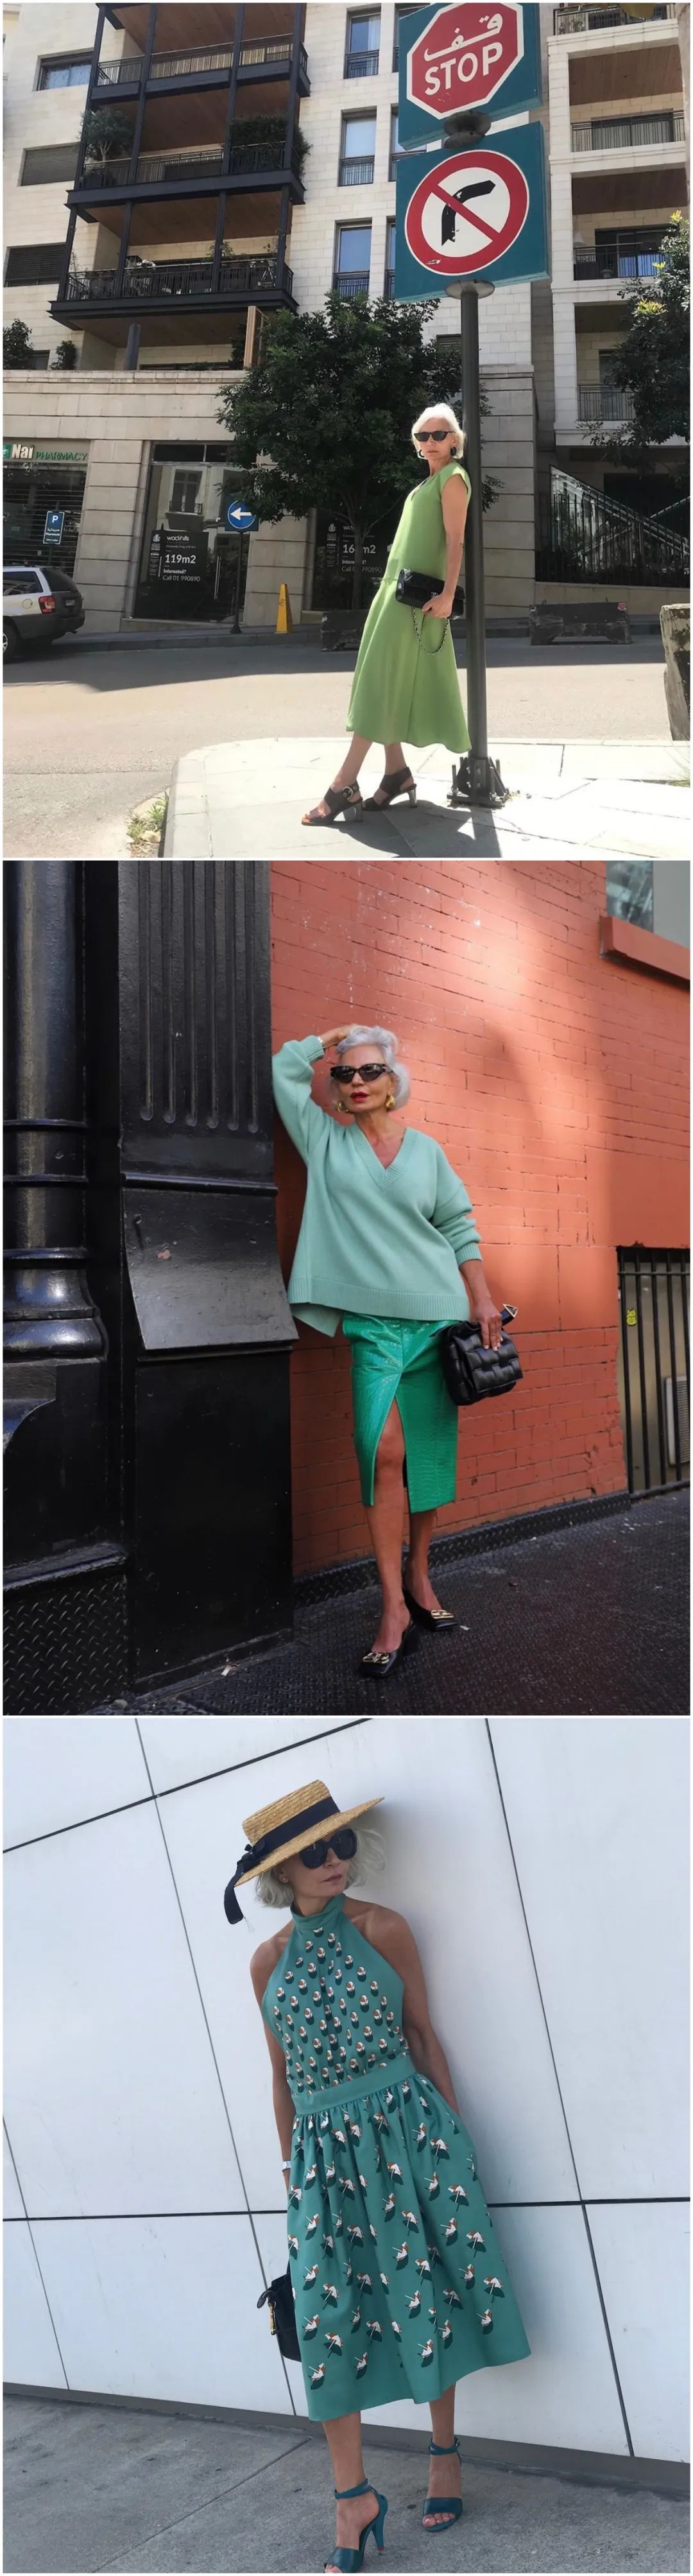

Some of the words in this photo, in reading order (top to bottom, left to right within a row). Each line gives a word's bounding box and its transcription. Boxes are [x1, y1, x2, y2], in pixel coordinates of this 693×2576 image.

[424, 13, 503, 62] قف
[425, 42, 503, 96] STOP
[35, 451, 88, 461] PHARMACY
[343, 544, 376, 554] 16m2
[165, 554, 196, 564] 119m2
